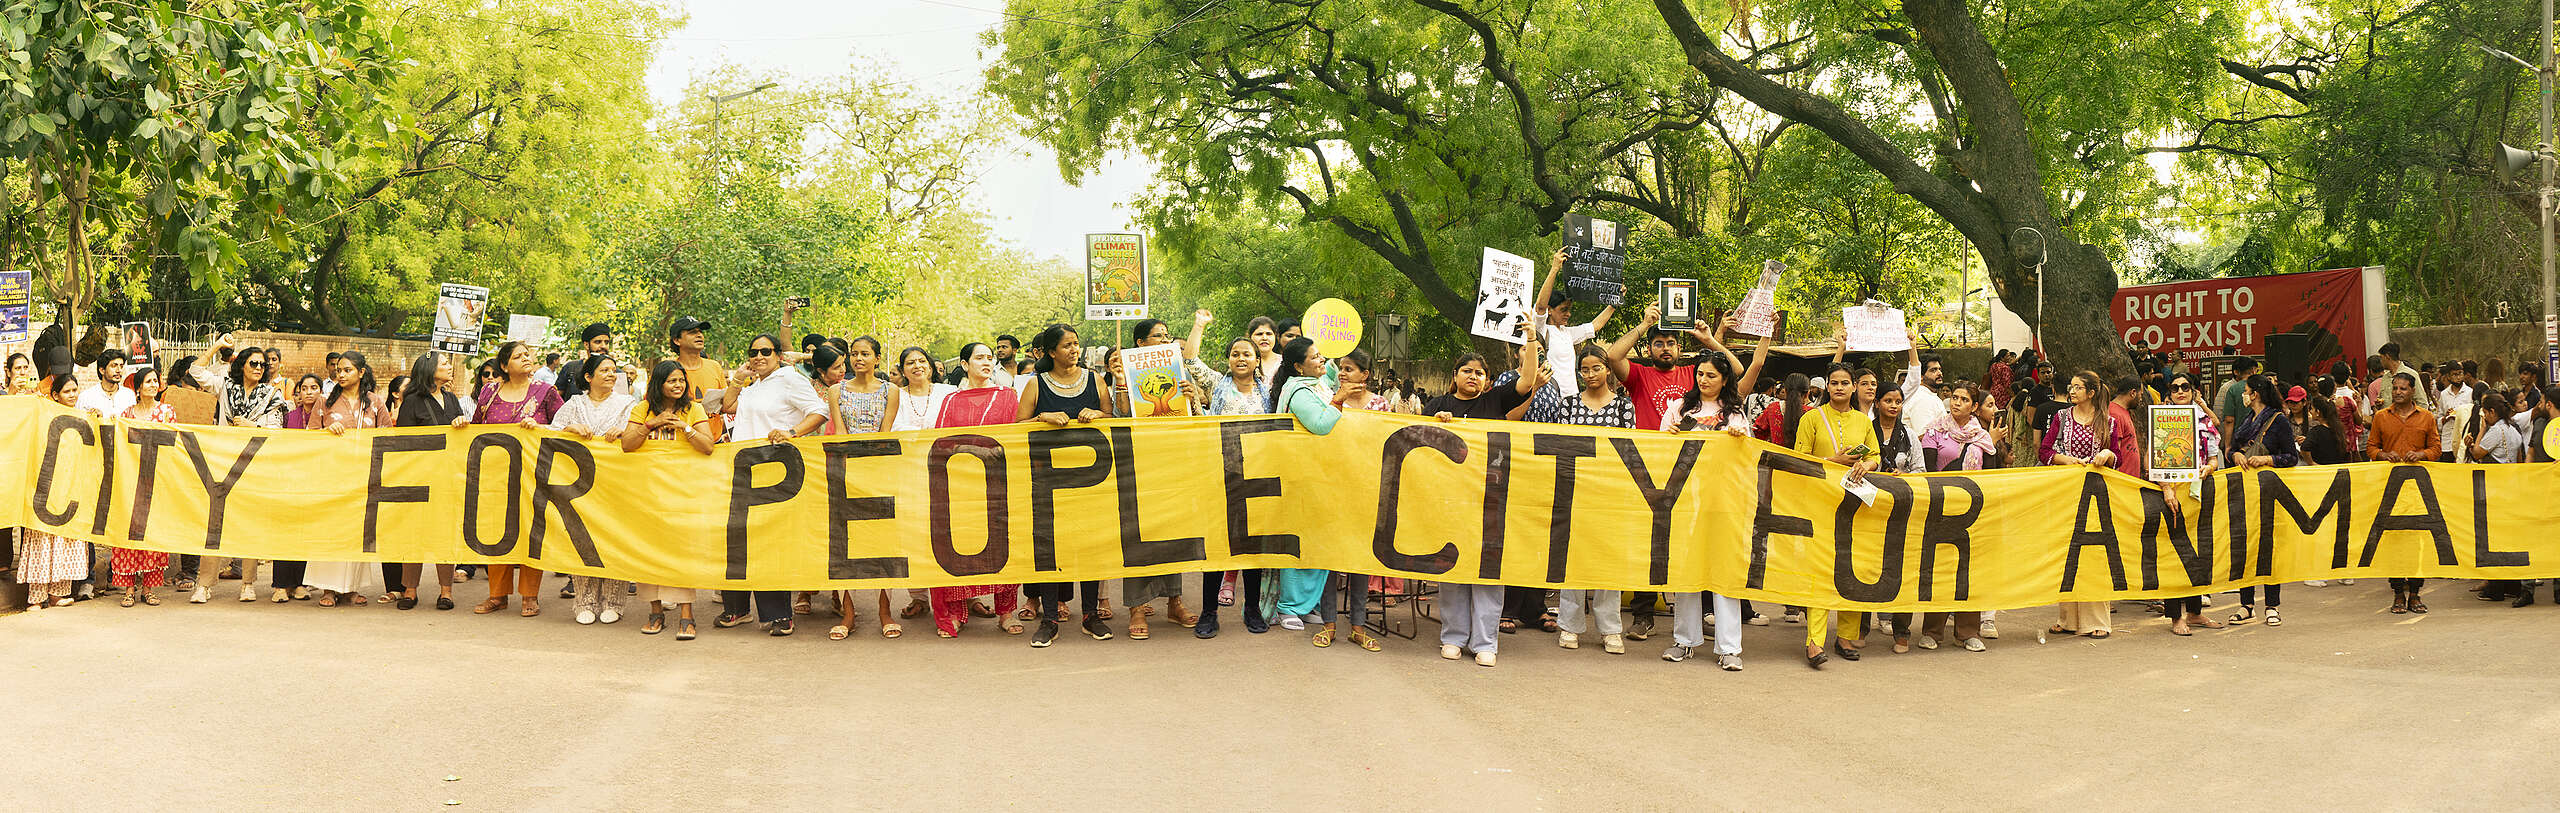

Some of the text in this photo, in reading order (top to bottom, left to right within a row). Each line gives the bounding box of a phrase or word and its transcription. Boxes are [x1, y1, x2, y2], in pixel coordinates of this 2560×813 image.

[2125, 286, 2254, 321] RIGHT TO
[1320, 314, 1349, 328] DELHI
[1320, 328, 1355, 342] RISING
[2124, 318, 2256, 350] CO-EXIST
[1128, 349, 1174, 362] DEFEND
[1135, 358, 1172, 370] EARTH
[32, 414, 2530, 604] CITY FOR PEOPLE CITY FOR ANIMAL
